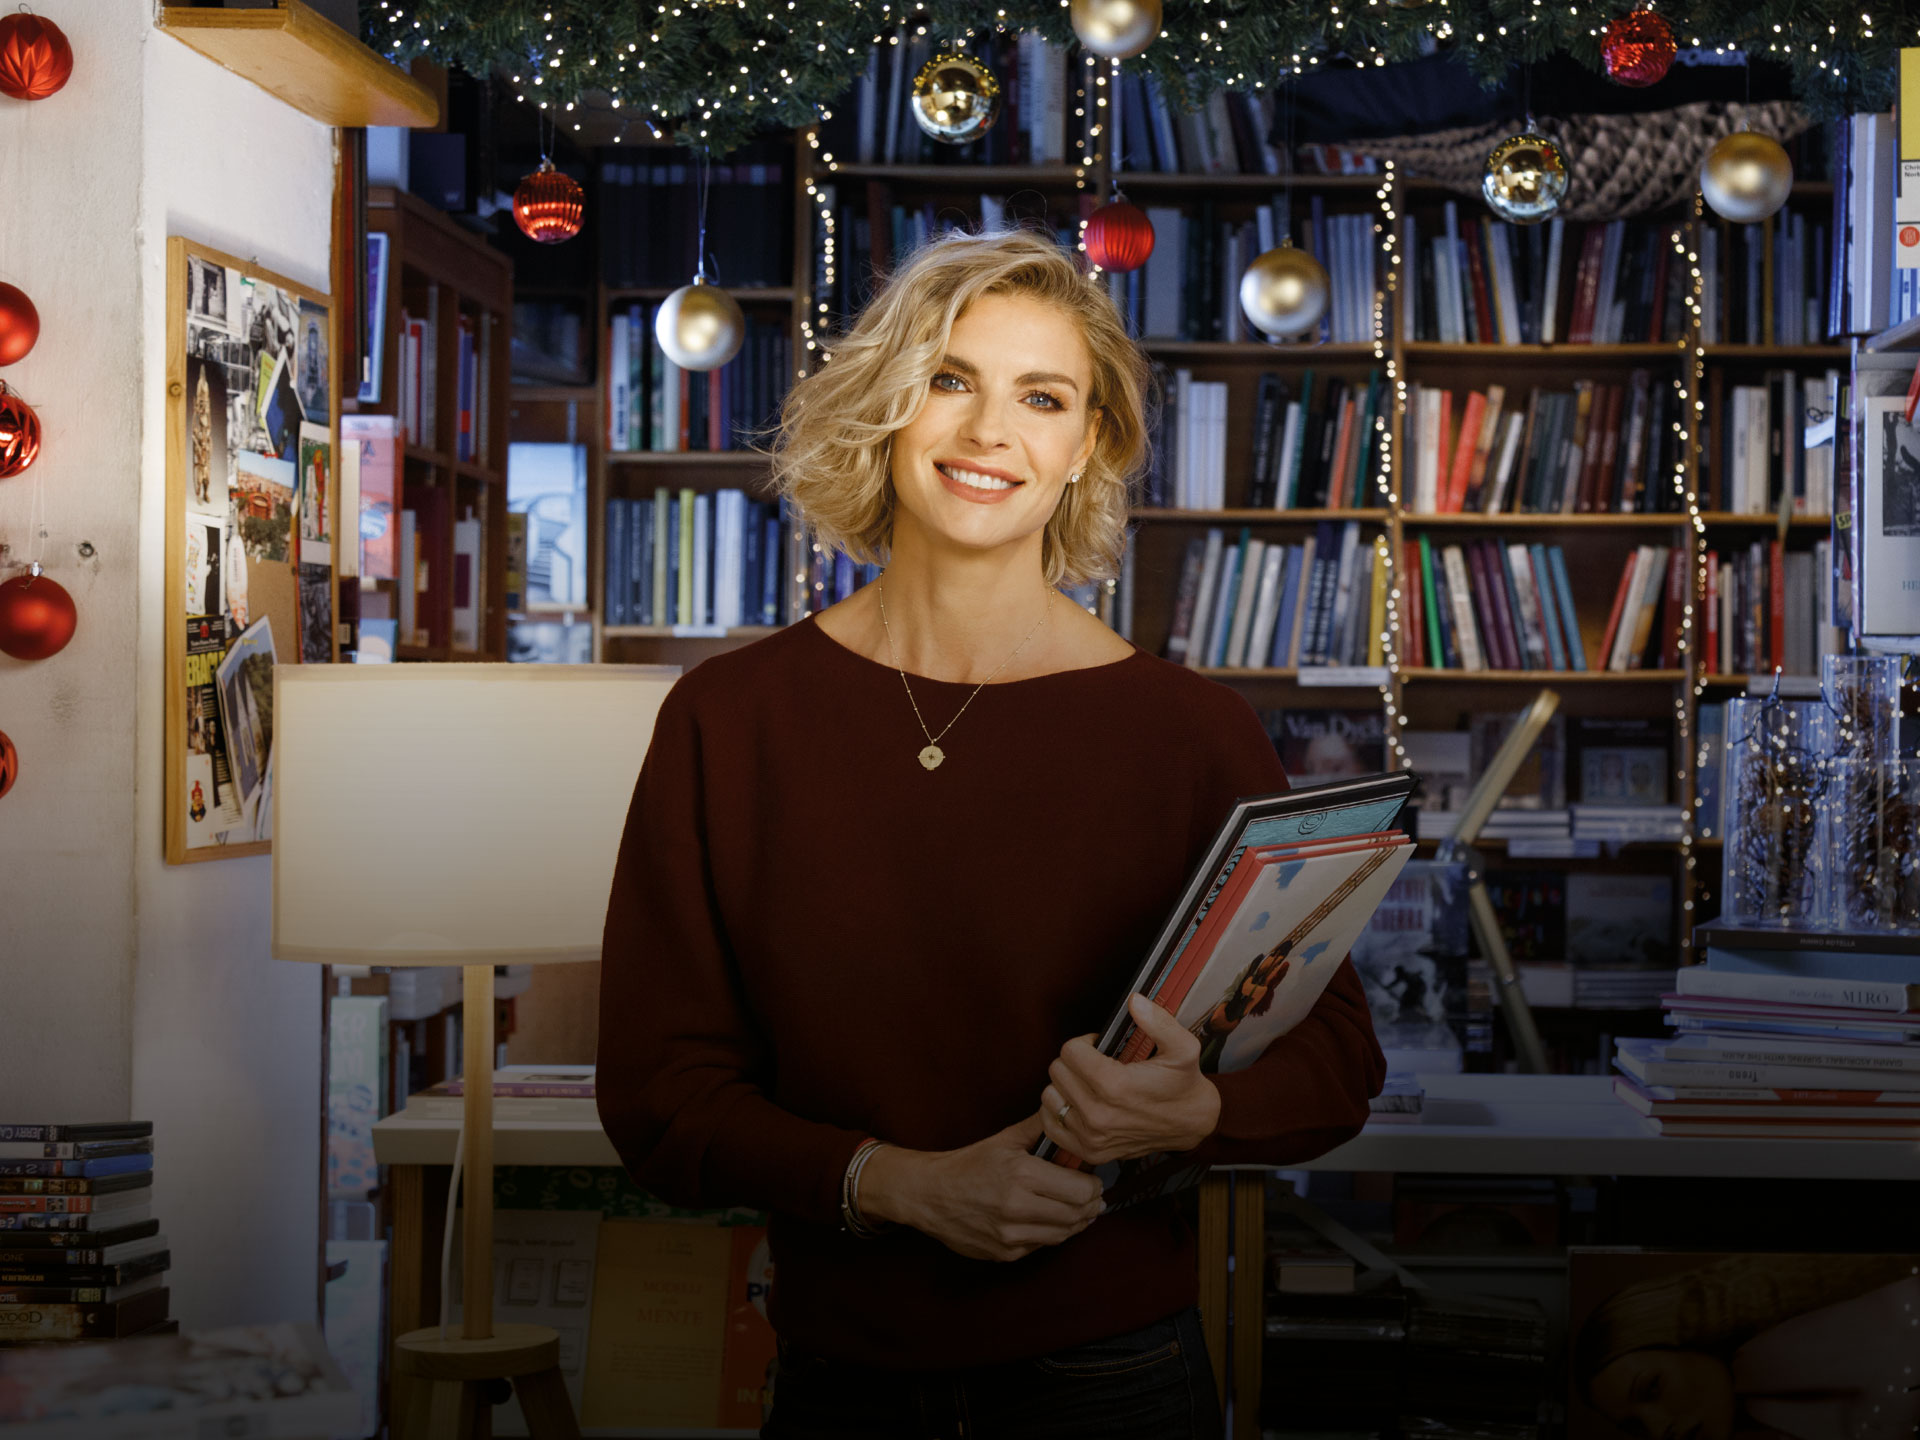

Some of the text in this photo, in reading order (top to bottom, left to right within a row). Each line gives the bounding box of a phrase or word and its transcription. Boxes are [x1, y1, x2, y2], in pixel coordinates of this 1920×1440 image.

[1286, 713, 1383, 744] Van Dyck
[1722, 1051, 1746, 1059] ALIEN
[1747, 1052, 1762, 1061] THE
[1764, 1053, 1785, 1062] WITH
[1728, 1071, 1758, 1083] Treno
[15, 1127, 44, 1140] JERRY
[637, 1307, 705, 1328] MENTE
